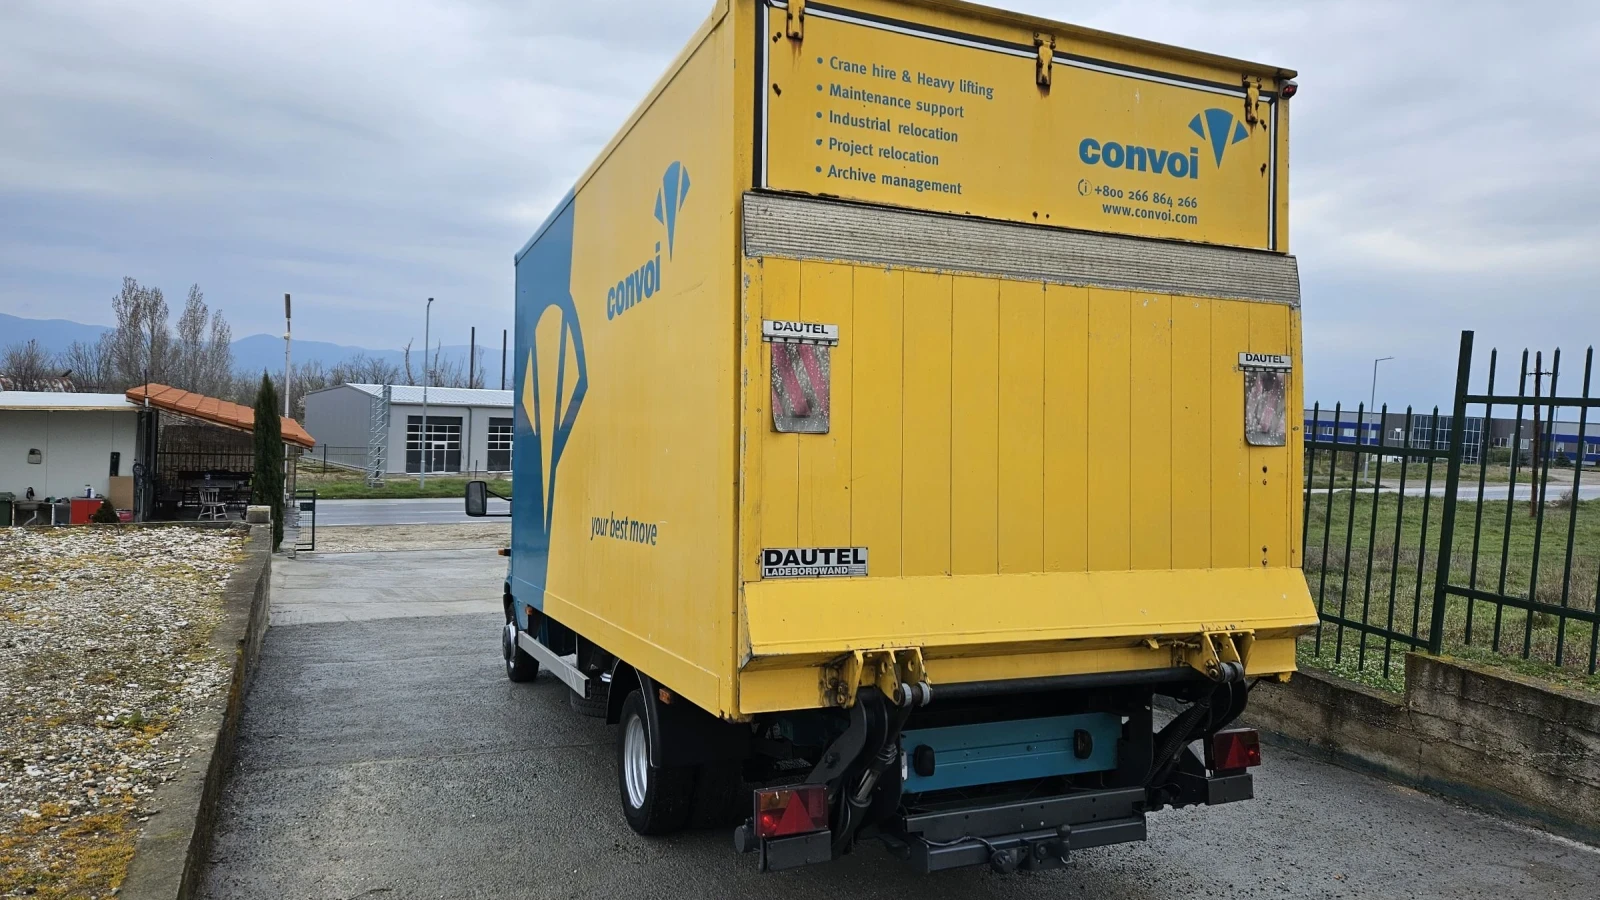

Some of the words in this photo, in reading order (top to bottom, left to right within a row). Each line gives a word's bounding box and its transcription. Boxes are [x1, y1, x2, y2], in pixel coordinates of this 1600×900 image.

[830, 56, 866, 75] Crane
[872, 64, 896, 80] hire
[902, 71, 911, 82] &
[918, 72, 954, 93] Heavy
[960, 80, 994, 99] lifting
[830, 84, 911, 109] Maintenance
[916, 100, 964, 118] support
[830, 111, 890, 132] Industrial
[899, 122, 958, 142] relocation
[829, 137, 873, 156] Project
[879, 145, 939, 165] relocation
[1079, 138, 1198, 179] convoi
[827, 164, 876, 183] Archive
[882, 173, 962, 194] management
[1094, 185, 1123, 198] +800
[1128, 190, 1148, 202] 266
[1153, 193, 1173, 208] 864
[1178, 196, 1197, 208] 266
[1102, 204, 1197, 224] www.convoi.com
[607, 241, 660, 320] convoi
[773, 321, 829, 335] DAUTEL
[1246, 354, 1284, 363] DAUTEL
[591, 517, 608, 541] your
[610, 511, 628, 540] best
[630, 521, 657, 546] move
[765, 549, 865, 566] DAUTEL
[766, 567, 848, 576] LADEBORDWAND
